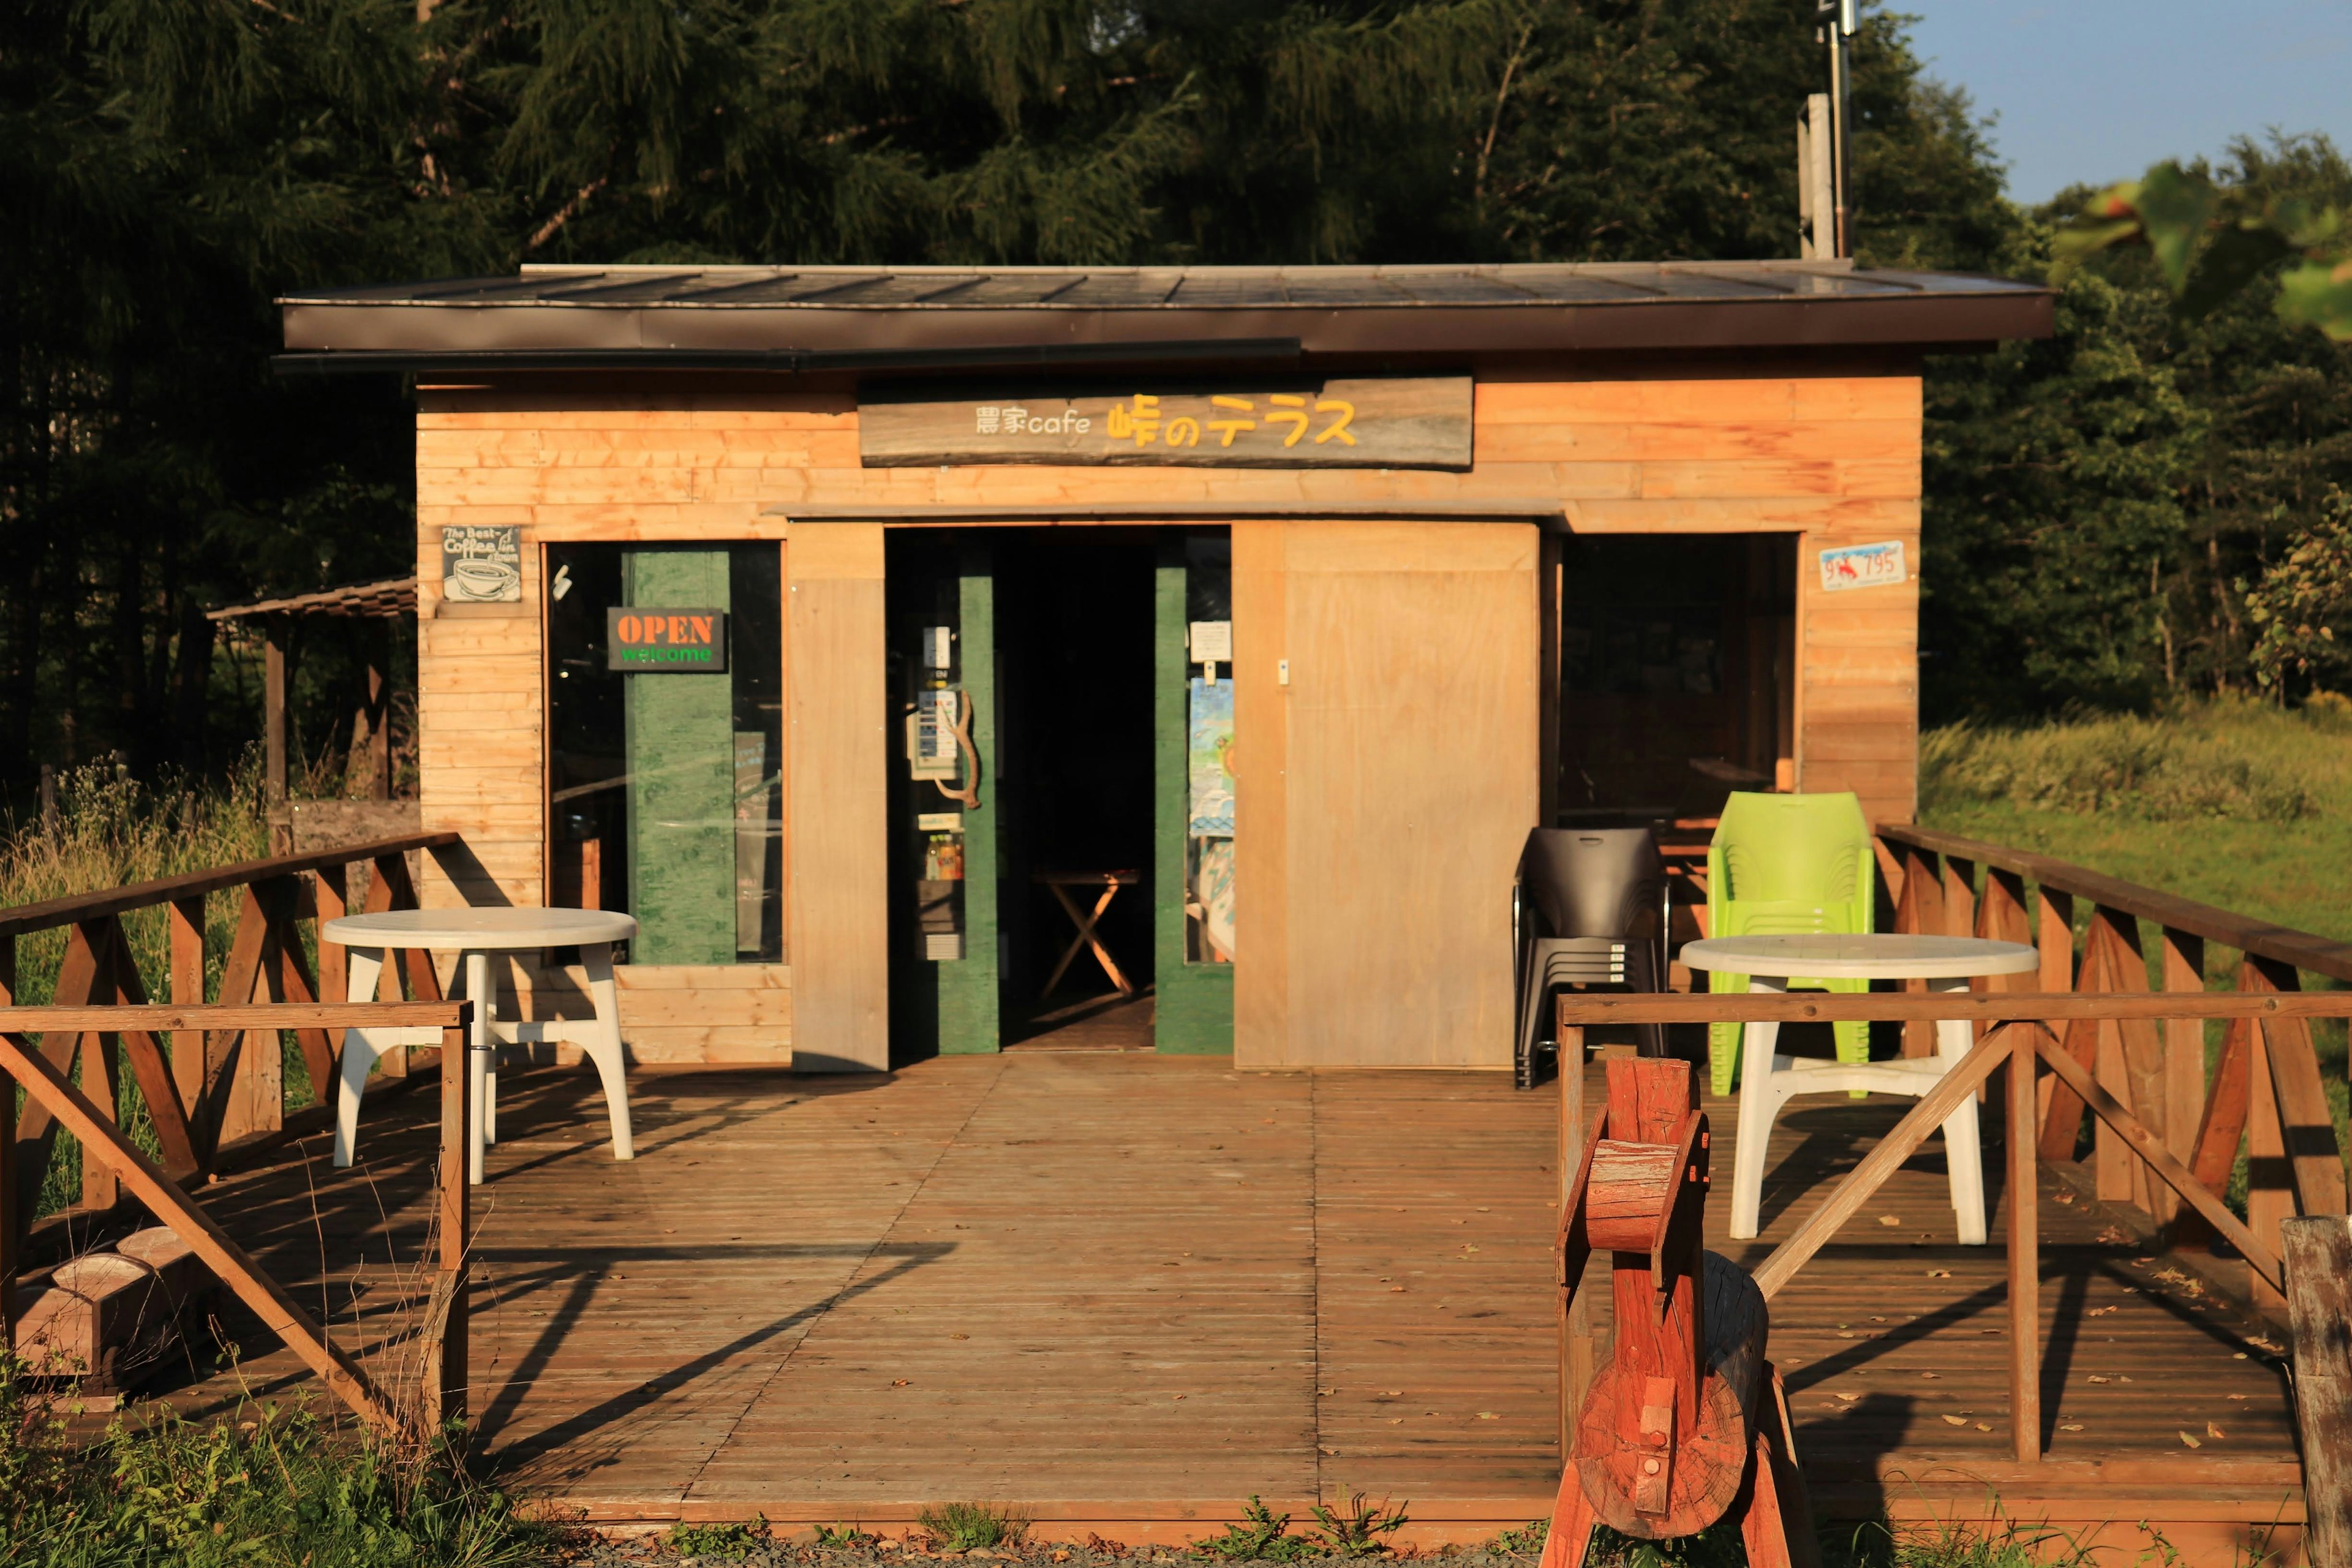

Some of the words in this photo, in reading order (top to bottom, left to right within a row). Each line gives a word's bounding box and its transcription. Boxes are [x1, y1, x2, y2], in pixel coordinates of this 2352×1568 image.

[976, 407, 1091, 435] 農家cafe
[1107, 394, 1355, 447] 峠のテラス
[443, 527, 465, 539] The
[444, 538, 496, 559] Coffee
[499, 540, 516, 552] in
[494, 552, 519, 563] town
[1866, 552, 1894, 575] 795
[617, 615, 714, 644] OPEN
[620, 646, 712, 662] welcome
